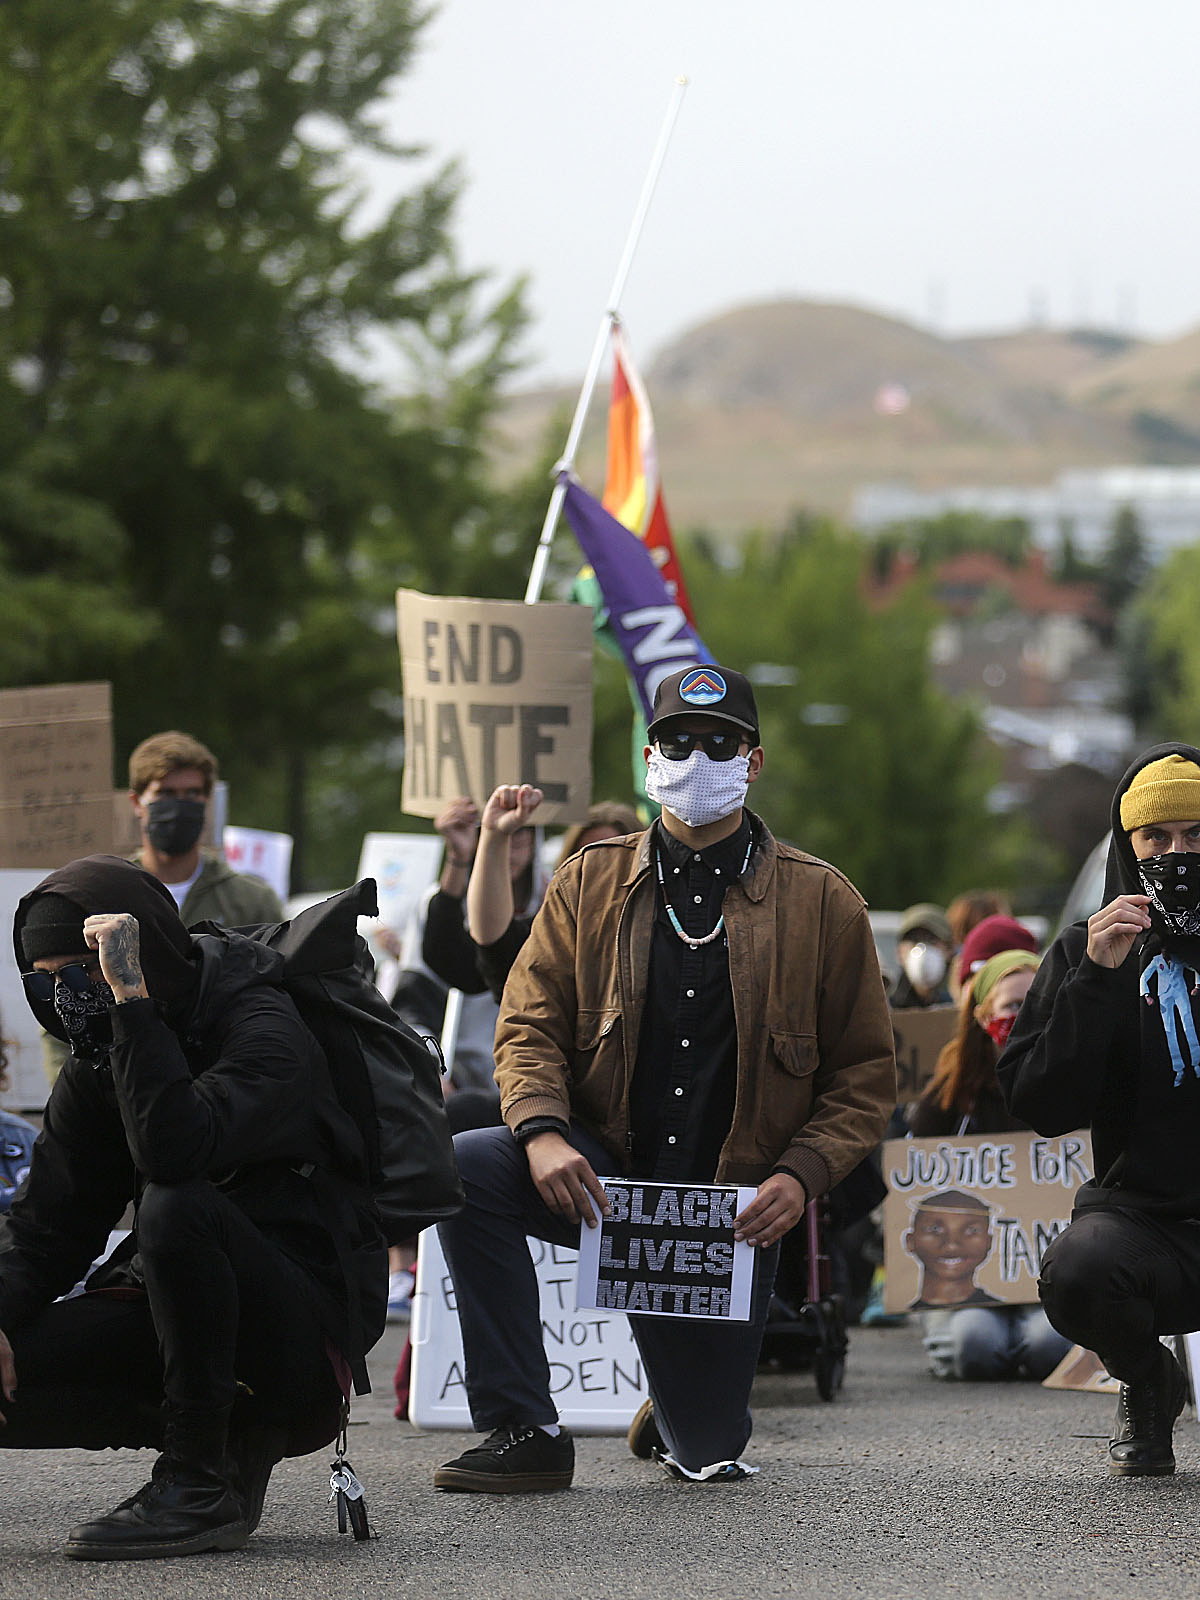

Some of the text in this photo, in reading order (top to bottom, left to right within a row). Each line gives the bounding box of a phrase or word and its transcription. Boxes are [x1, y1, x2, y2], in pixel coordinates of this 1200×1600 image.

[424, 620, 523, 684] END
[410, 697, 569, 803] HATE
[891, 1138, 1092, 1192] JUSTICE FOR
[603, 1186, 737, 1228] BLACK
[600, 1235, 733, 1276] LIVES
[993, 1217, 1072, 1282] TAM
[597, 1279, 731, 1316] MATTER
[541, 1320, 611, 1346] NOT
[440, 1358, 641, 1401] ADEN
